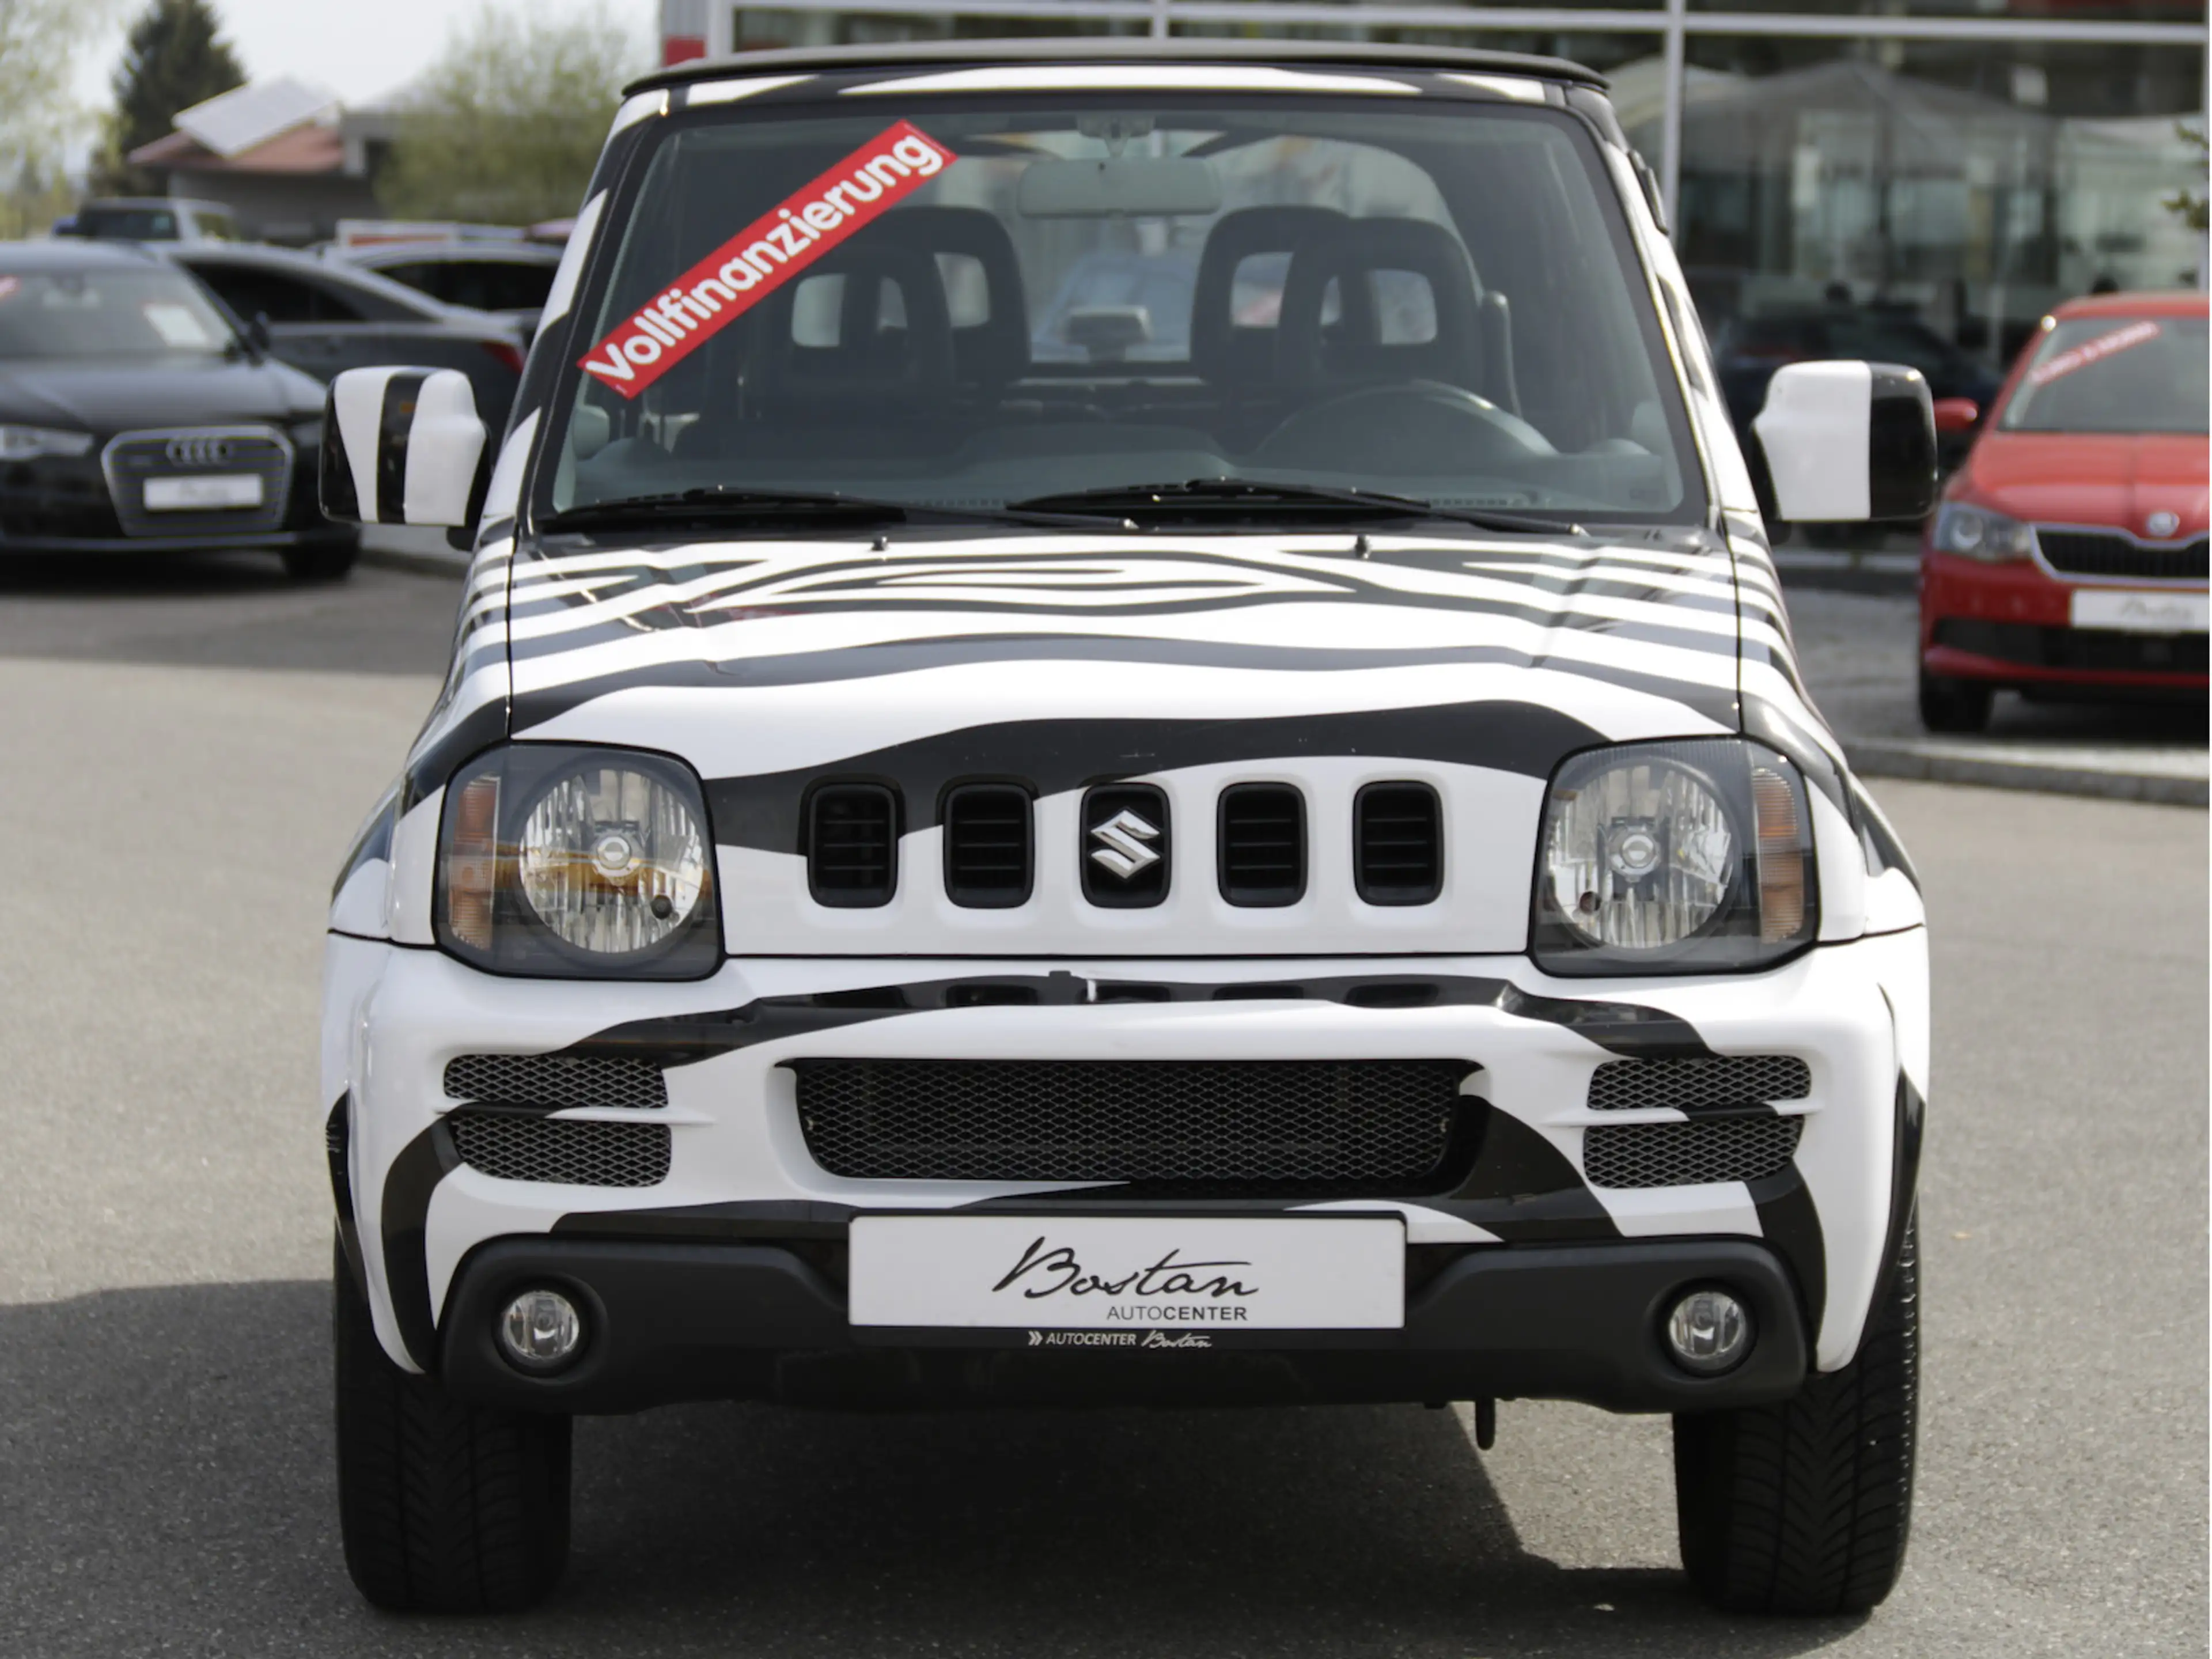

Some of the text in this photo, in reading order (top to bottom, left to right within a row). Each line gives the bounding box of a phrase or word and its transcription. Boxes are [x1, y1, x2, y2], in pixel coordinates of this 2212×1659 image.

[585, 134, 944, 381] Vollfinanzierung
[991, 1236, 1259, 1299] Bostan
[1107, 1306, 1248, 1321] AUTOCENTER
[1046, 1330, 1213, 1349] AUTOCENTER Bostan
